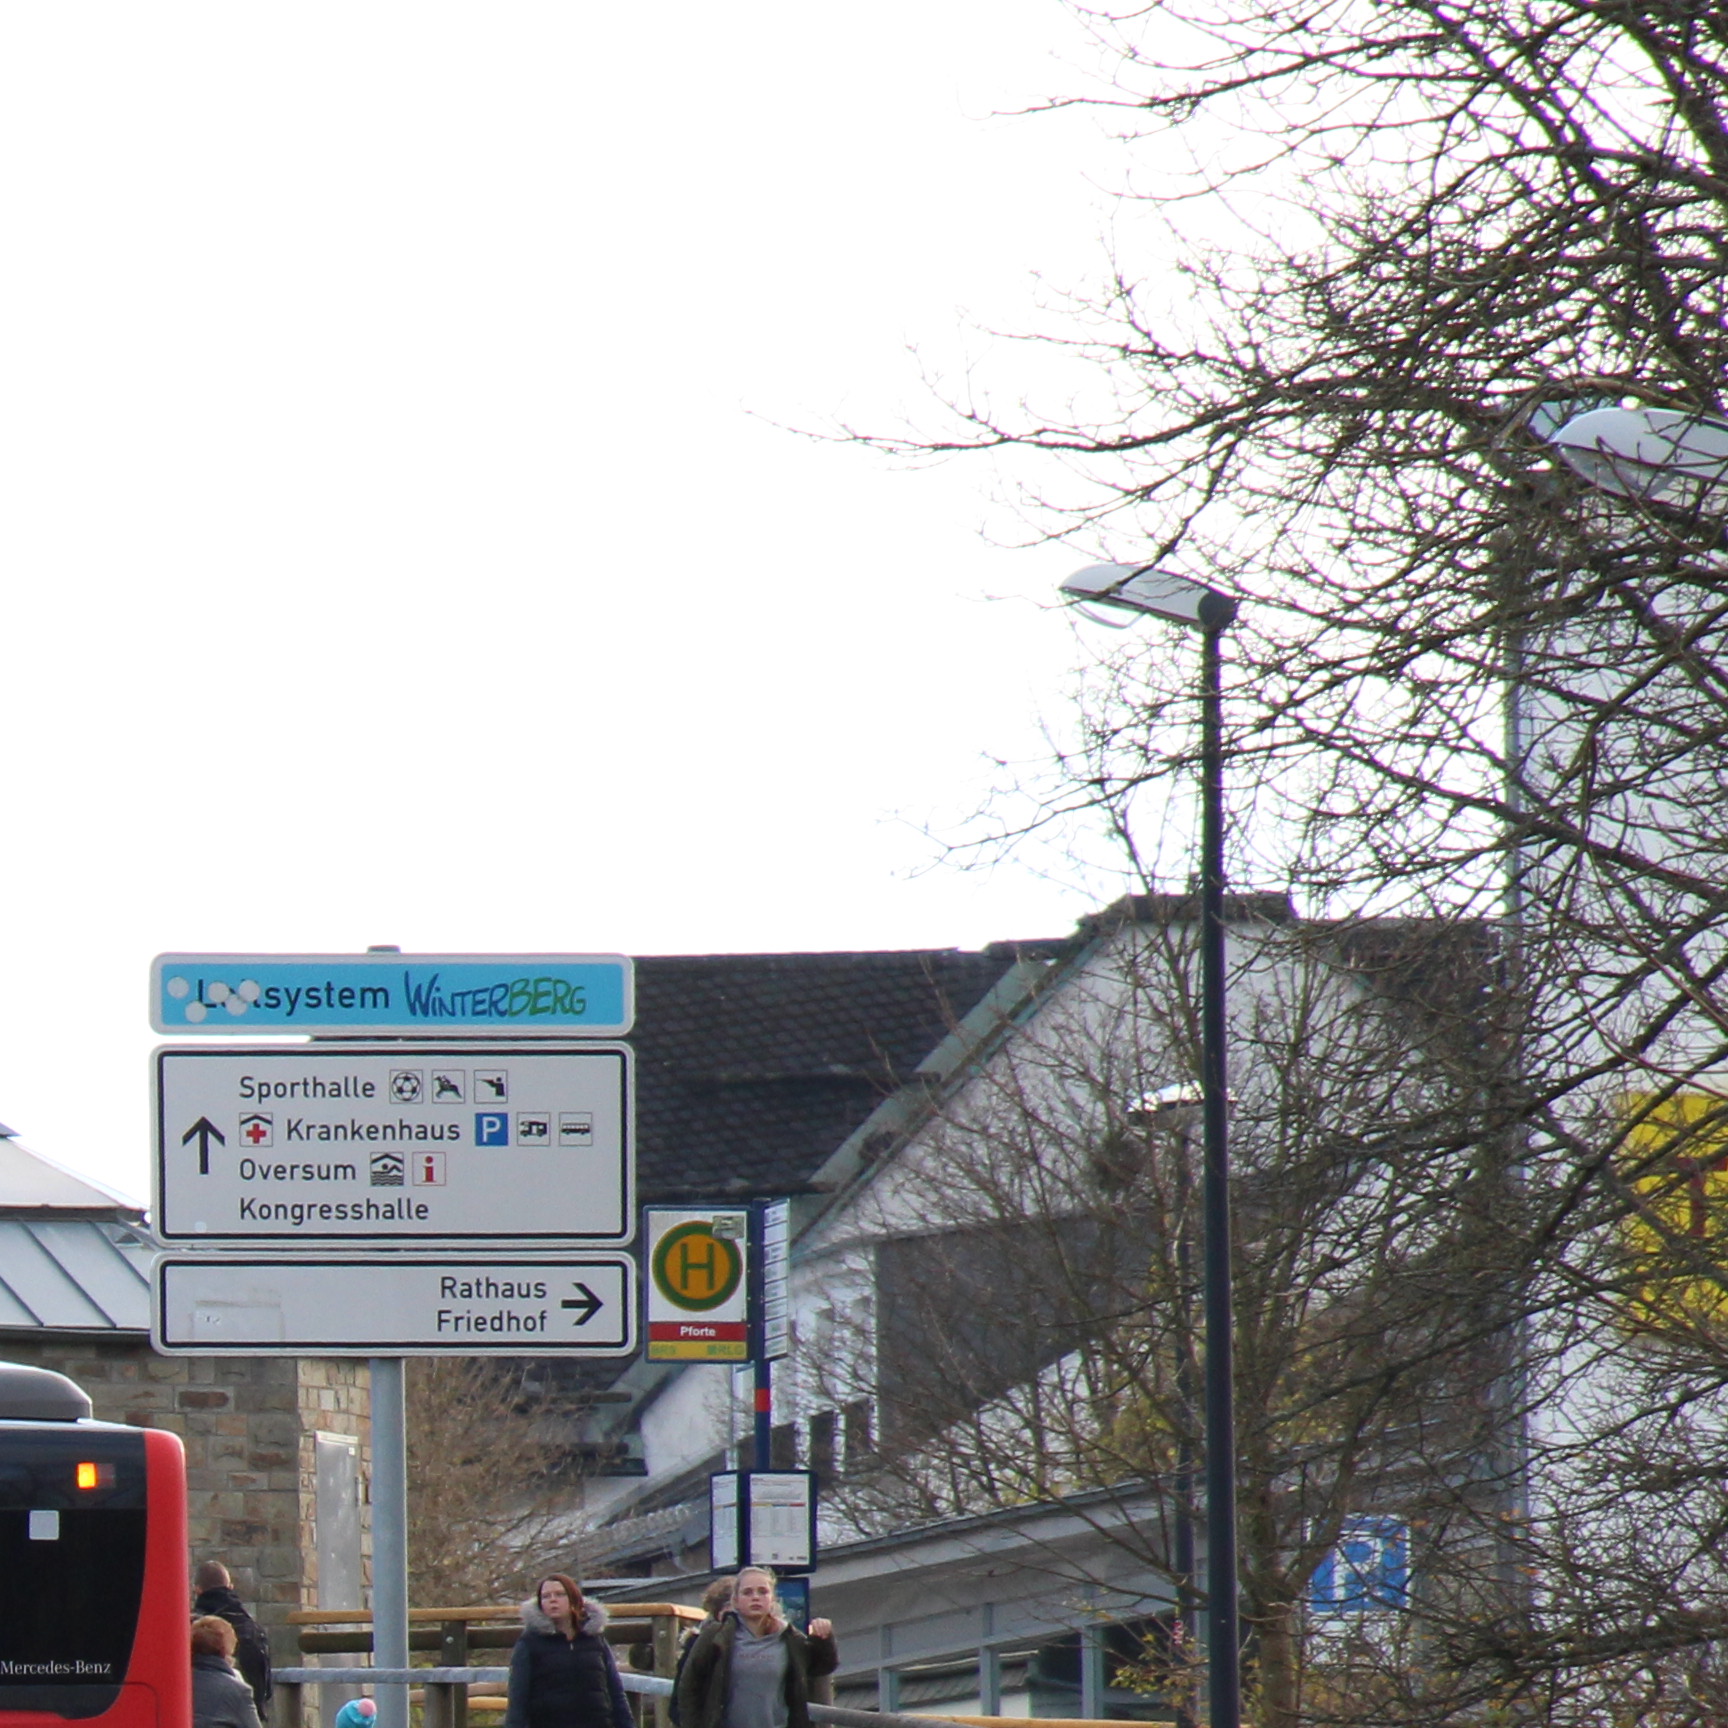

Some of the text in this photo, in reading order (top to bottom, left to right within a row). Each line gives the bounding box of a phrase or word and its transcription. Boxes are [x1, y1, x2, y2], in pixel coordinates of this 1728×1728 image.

[198, 979, 389, 1016] Lsystem
[239, 1076, 376, 1104] Sporthalle
[286, 1119, 461, 1141] Krankenhaus
[239, 1159, 356, 1181] Oversum
[239, 1197, 429, 1225] Kongresshalle
[680, 1243, 715, 1291] H
[440, 1276, 547, 1299] Rathaus
[437, 1310, 548, 1332] Friedhof
[679, 1326, 716, 1337] Pforte
[0, 1659, 111, 1676] Mercedes-Benz
